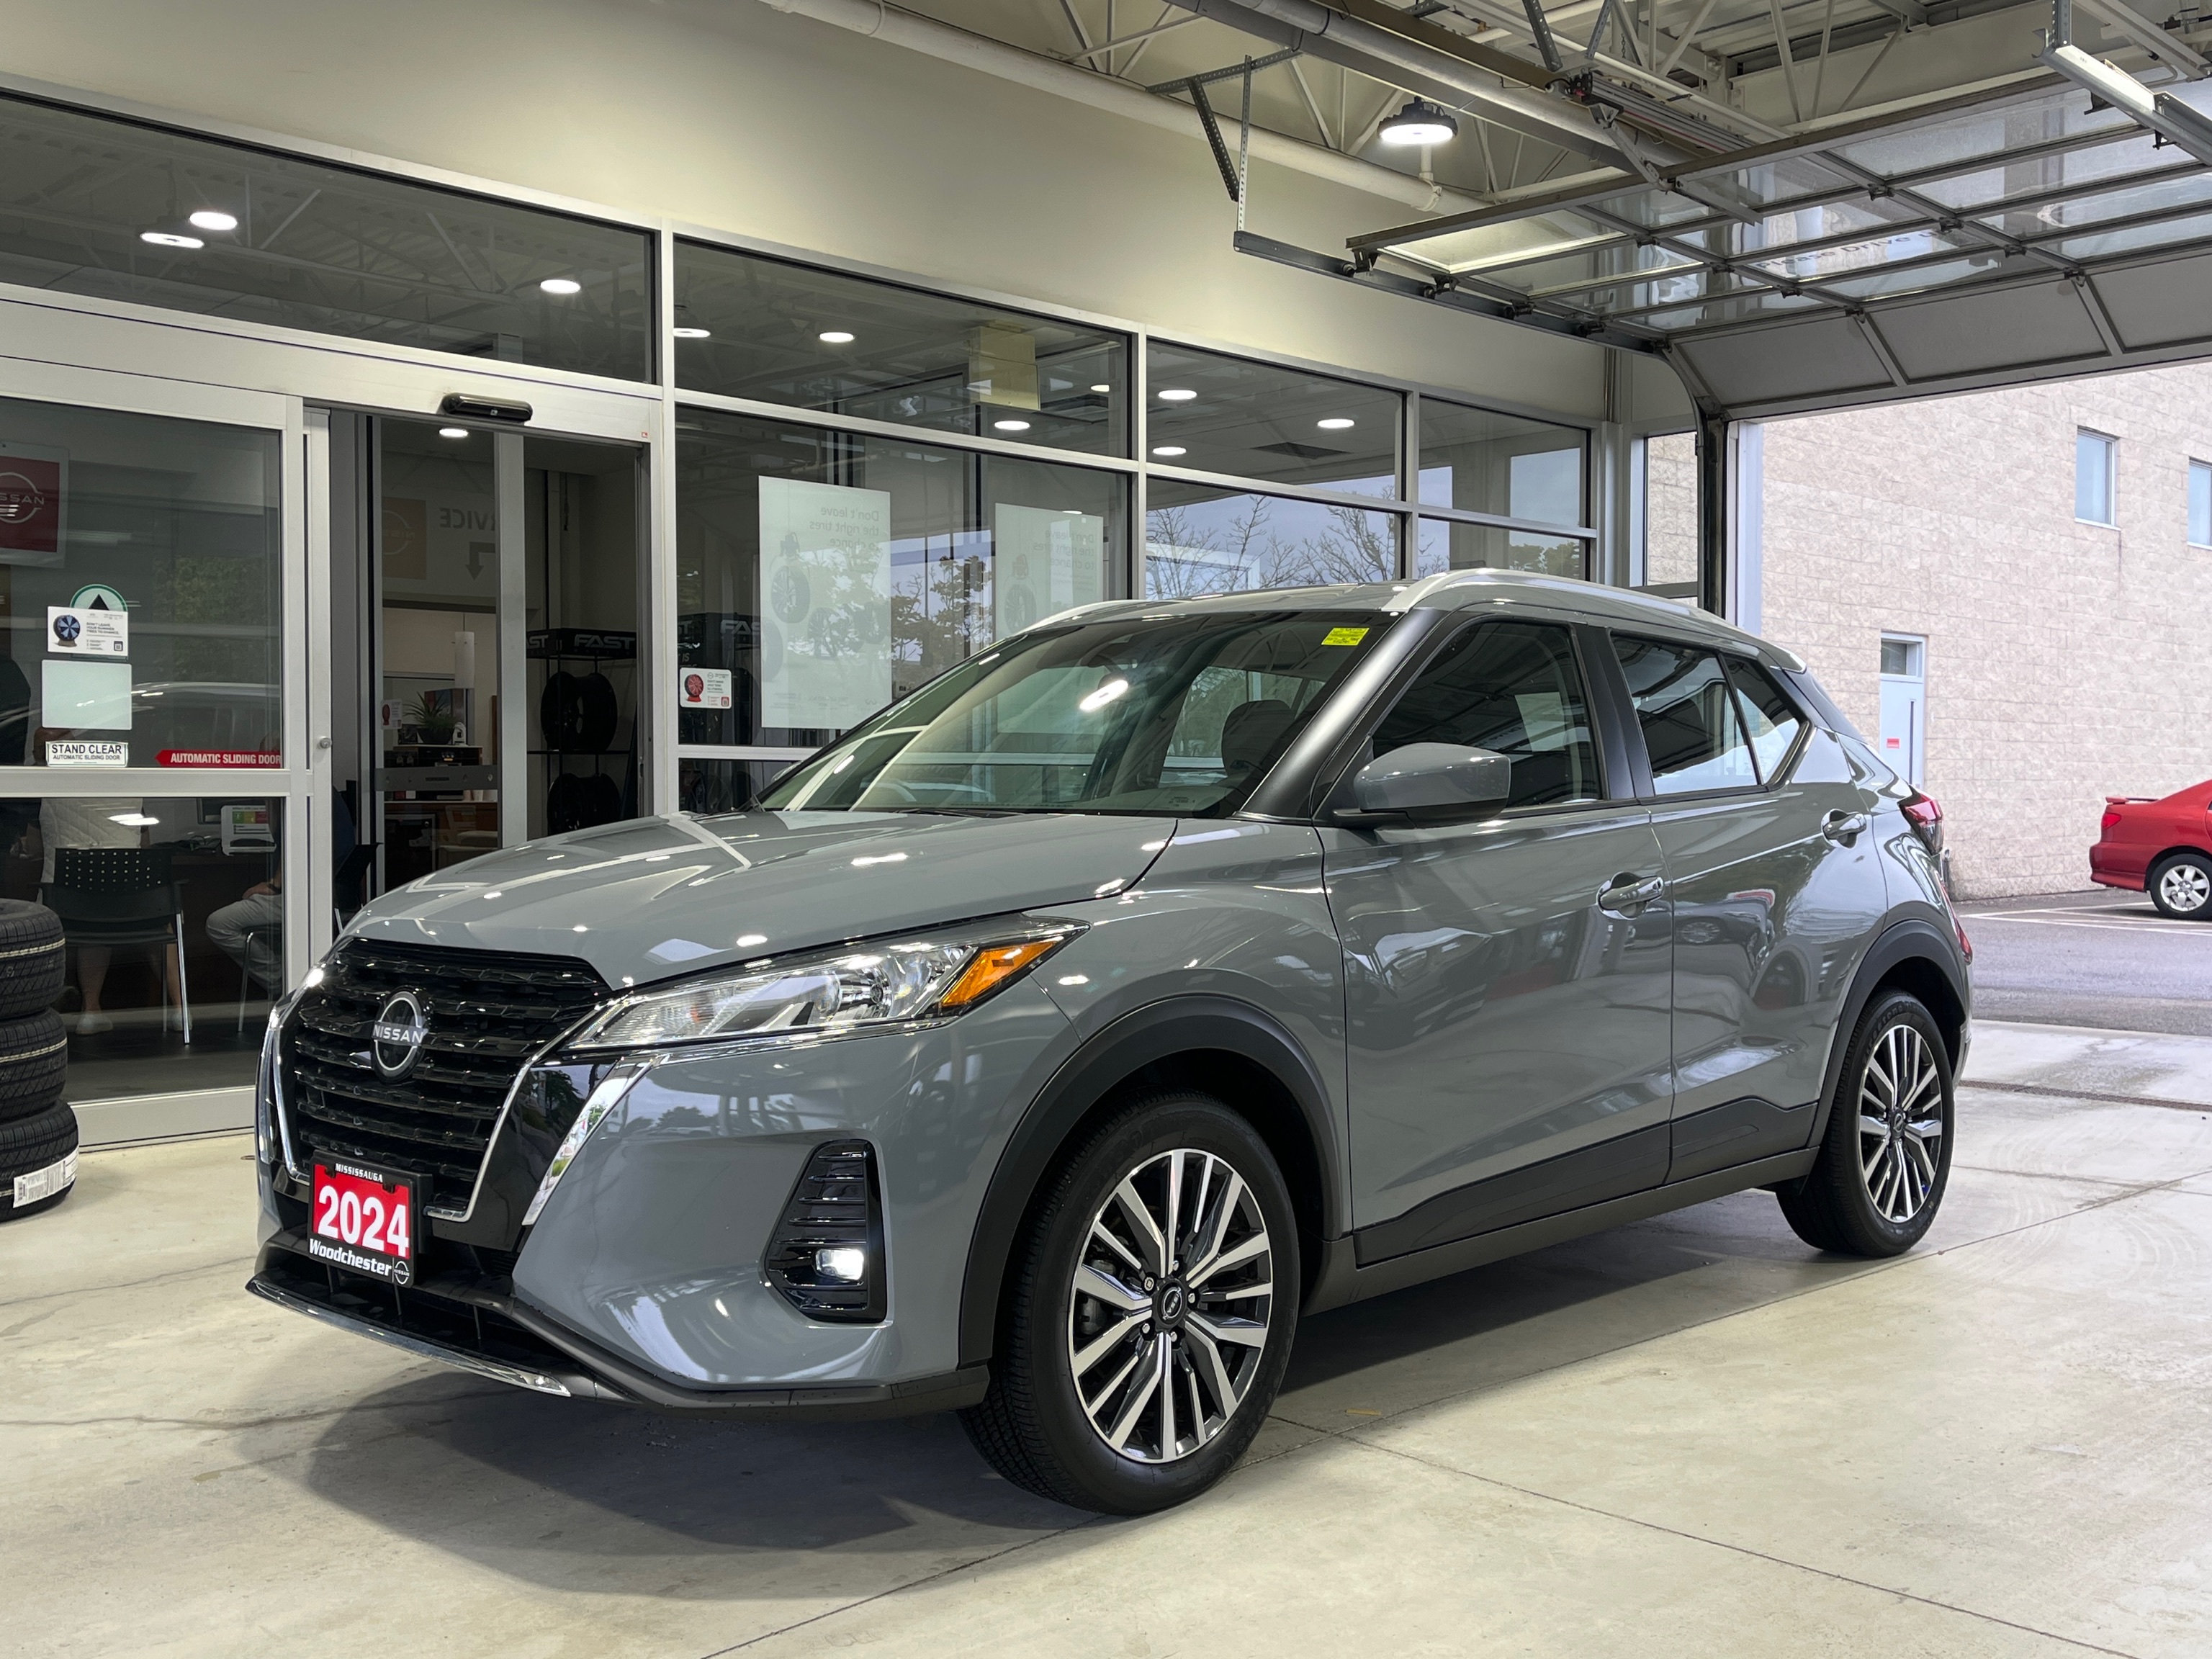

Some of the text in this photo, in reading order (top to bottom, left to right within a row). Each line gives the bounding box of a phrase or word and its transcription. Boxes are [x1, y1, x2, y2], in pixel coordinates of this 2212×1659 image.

[1840, 237, 1911, 252] Drive
[574, 634, 636, 649] FAST
[51, 744, 122, 754] STAND CLEAR
[170, 752, 221, 764] AUTOMATIC
[222, 753, 256, 765] SLIDING
[373, 1025, 424, 1043] NISSAN
[335, 1163, 383, 1182] MISSISSAUGA
[318, 1185, 409, 1257] 2024
[309, 1238, 392, 1276] Woodchester
